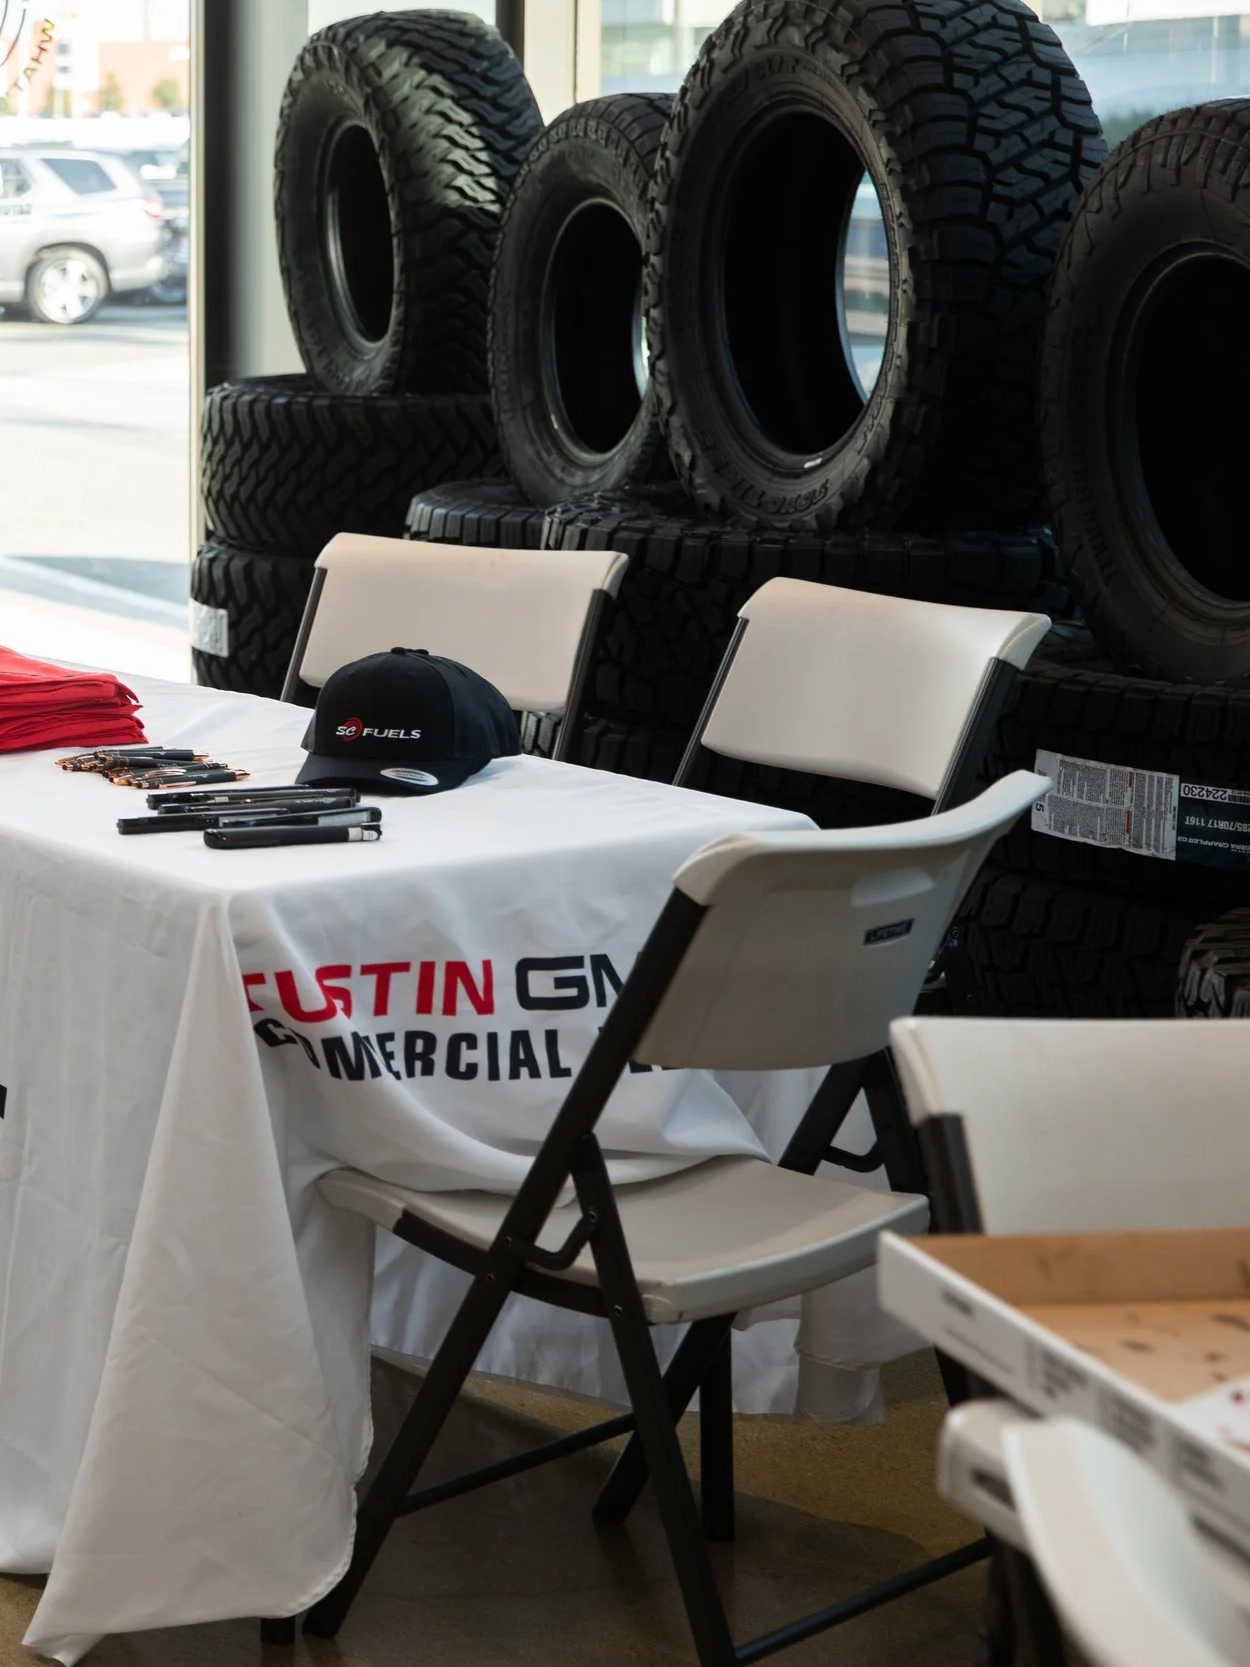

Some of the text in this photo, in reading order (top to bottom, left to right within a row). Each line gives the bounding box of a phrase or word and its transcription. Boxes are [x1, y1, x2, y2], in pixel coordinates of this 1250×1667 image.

[335, 725, 422, 739] SC FUELS
[1182, 784, 1228, 801] 224230
[515, 951, 642, 1012] GM
